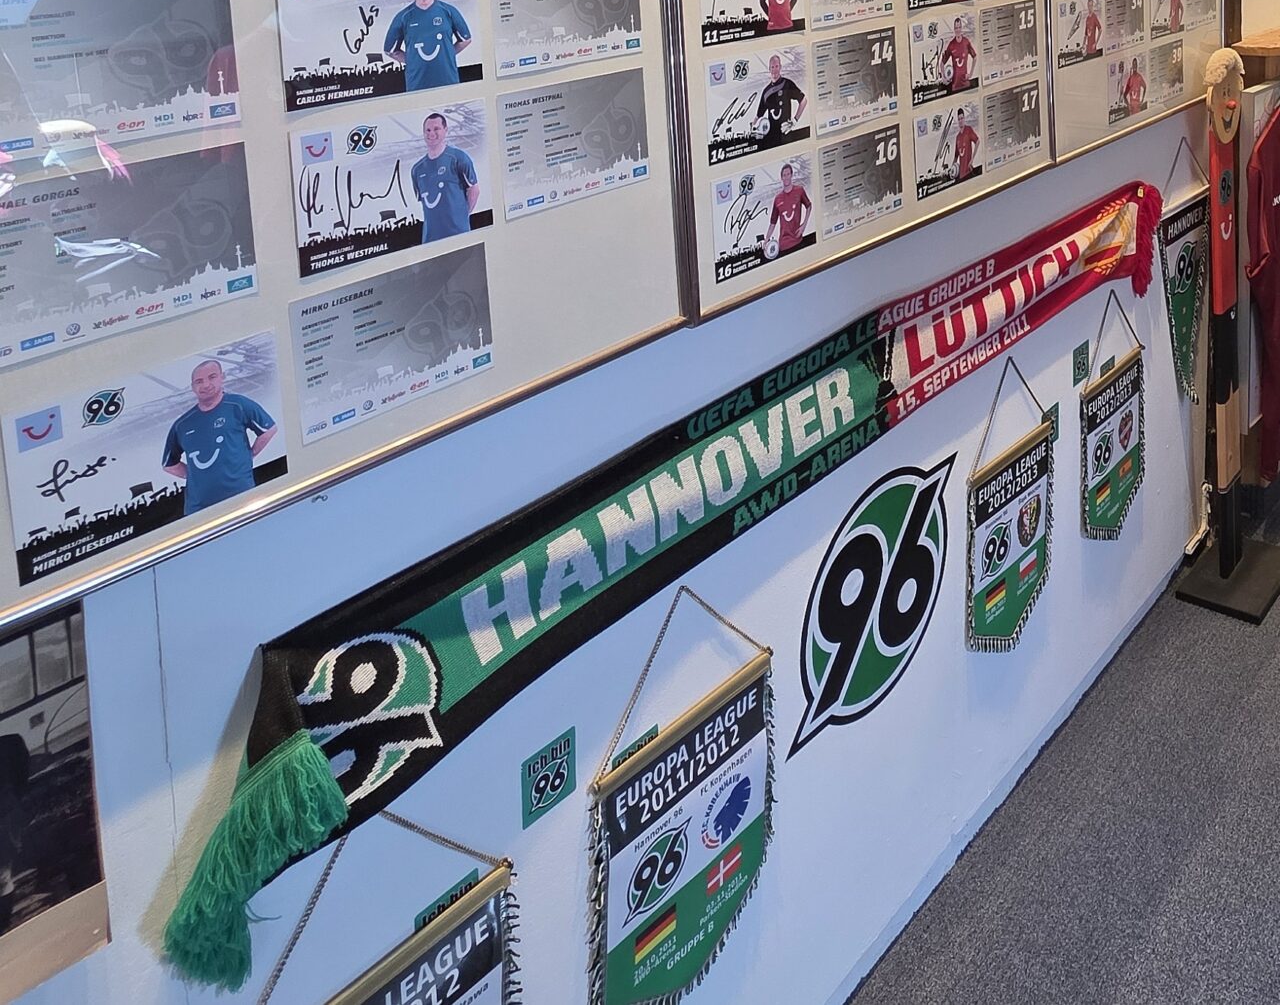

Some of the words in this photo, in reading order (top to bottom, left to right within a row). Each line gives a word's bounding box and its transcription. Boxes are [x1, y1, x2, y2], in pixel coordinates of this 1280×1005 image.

[703, 29, 719, 45] 11
[1019, 8, 1035, 31] 15
[870, 40, 894, 66] 14
[1171, 47, 1183, 65] 39
[296, 93, 326, 106] CARLOS
[328, 86, 374, 101] HERNANDEZ
[504, 98, 531, 110] THOMAS
[531, 92, 564, 105] WESTPHAL
[913, 92, 924, 104] 15
[1021, 89, 1038, 113] 17
[349, 130, 376, 153] 96
[710, 149, 726, 165] 14
[875, 137, 898, 166] 16
[32, 187, 80, 205] GORGAS
[918, 186, 929, 199] 17
[1166, 204, 1205, 241] HANNOVER
[309, 255, 345, 271] THOMAS
[346, 243, 389, 260] WESTPHAL
[717, 264, 732, 281] 16
[1175, 244, 1196, 293] 96
[173, 293, 193, 304] HDI
[301, 301, 329, 317] MIRKO
[331, 288, 375, 309] LIESEBACH
[903, 238, 1082, 380] LÜTTICH
[686, 394, 760, 442] UEFA
[761, 326, 852, 403] EUROPA
[853, 296, 925, 346] LEAGUE
[927, 267, 984, 314] GRUPPE
[984, 258, 996, 280] B
[895, 388, 921, 424] 15.
[922, 339, 1000, 403] SEPTEMBER
[998, 312, 1032, 352] 2011
[85, 390, 124, 424] 96
[1087, 385, 1115, 417] EUROPA
[1116, 364, 1140, 395] LEAGUE
[1095, 384, 1133, 425] 2012/2013
[731, 409, 883, 537] AWD-ARENA
[978, 474, 1013, 506] EUROPA
[1014, 441, 1048, 485] LEAGUE
[1093, 432, 1114, 479] 96
[987, 466, 1039, 514] 2012/2013
[460, 366, 857, 667] HANNOVER
[33, 551, 72, 576] MIRKO
[75, 525, 135, 559] LIESEBACH
[981, 527, 1011, 576] 96
[792, 460, 952, 752] 96
[527, 755, 550, 779] Ich
[550, 739, 572, 761] bin
[616, 747, 688, 818] EUROPA
[694, 687, 758, 753] LEAGUE
[700, 786, 709, 797] FC
[710, 747, 753, 789] Kopenhagen
[530, 759, 568, 812] 96
[638, 724, 741, 824] 2011/2012
[633, 813, 673, 854] Hannover
[673, 805, 684, 819] 96
[627, 820, 690, 922] 96
[666, 929, 705, 971] GRUPPE
[707, 920, 715, 934] B
